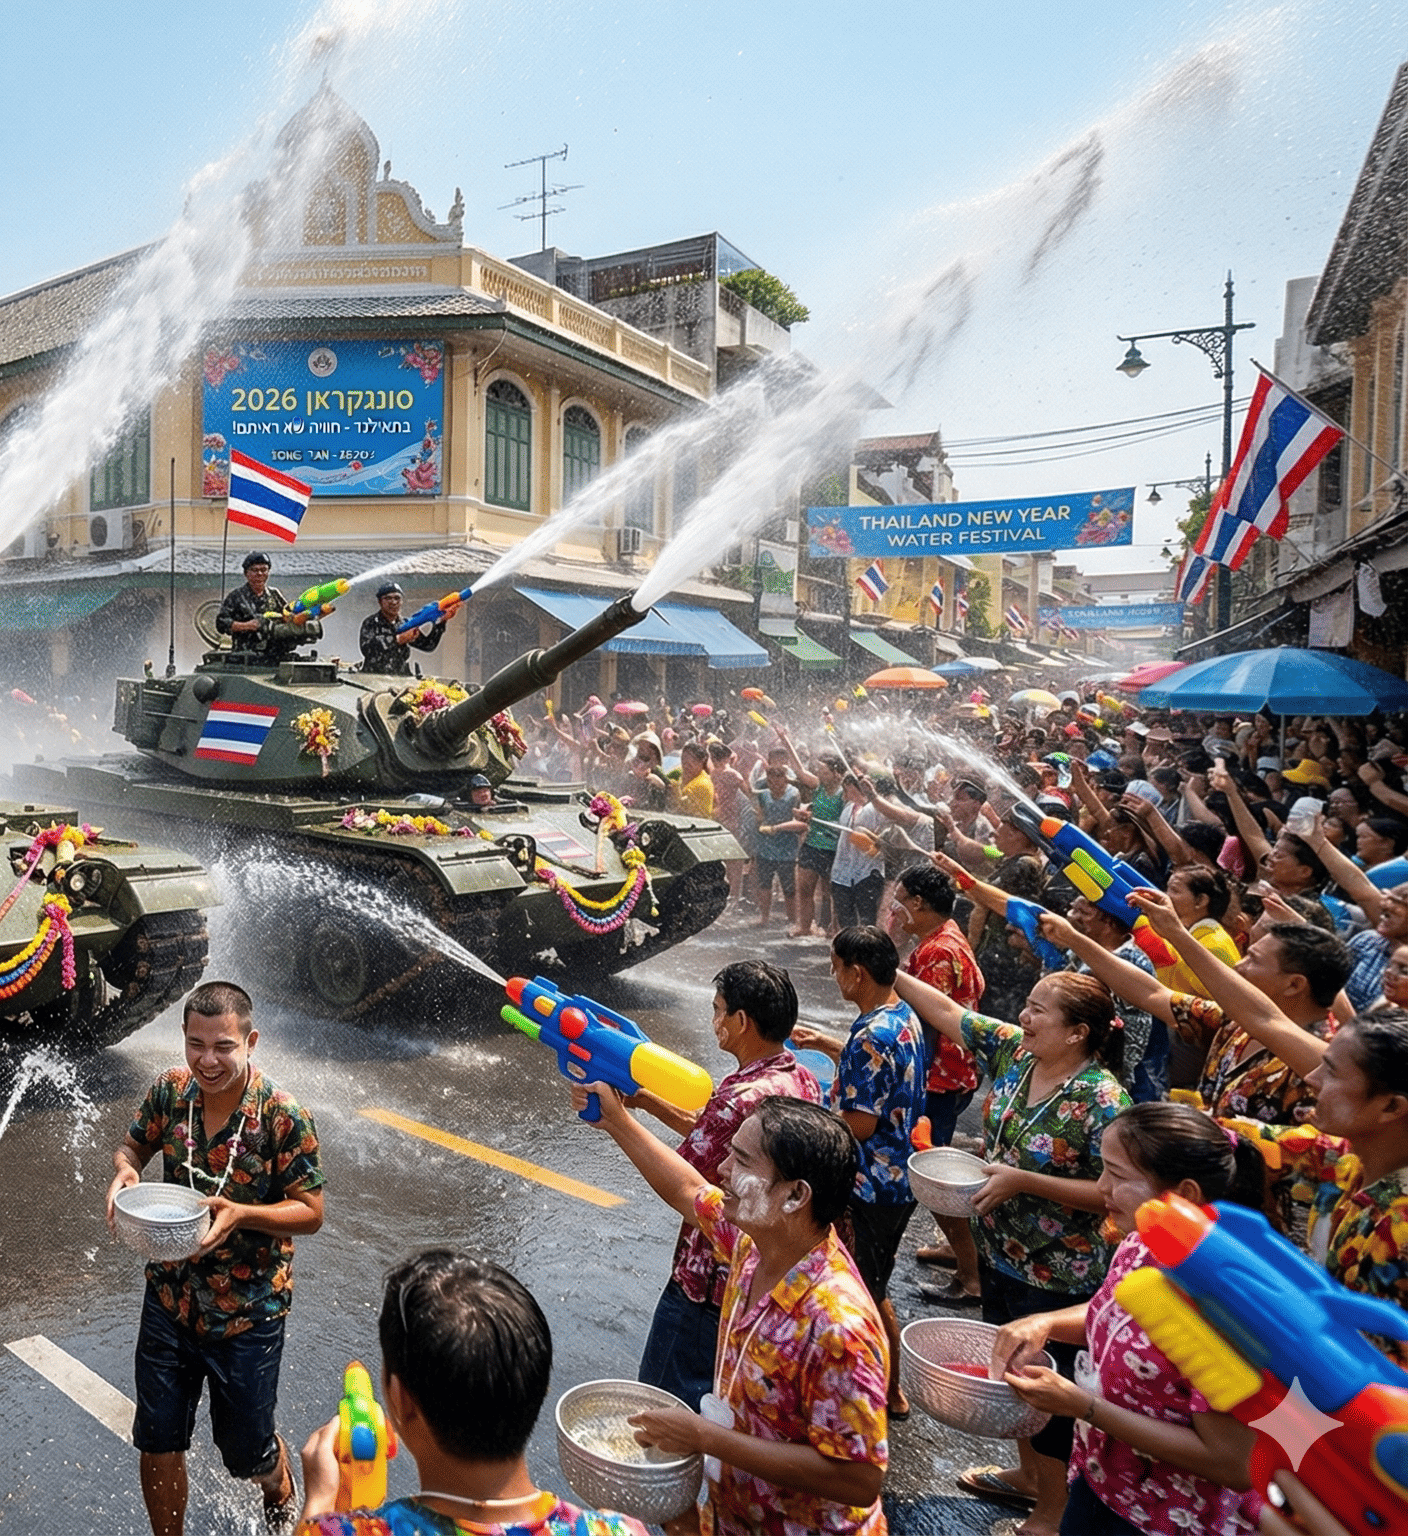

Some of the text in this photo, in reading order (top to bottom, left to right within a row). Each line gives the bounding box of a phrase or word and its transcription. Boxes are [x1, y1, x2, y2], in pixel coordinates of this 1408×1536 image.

[232, 388, 414, 416] סונגקראן 2026
[232, 420, 280, 434] ראיתם!
[309, 421, 341, 434] חוויה
[859, 505, 1071, 530] THAILAND NEW YEAR
[887, 527, 1046, 546] WATER FESTIVAL
